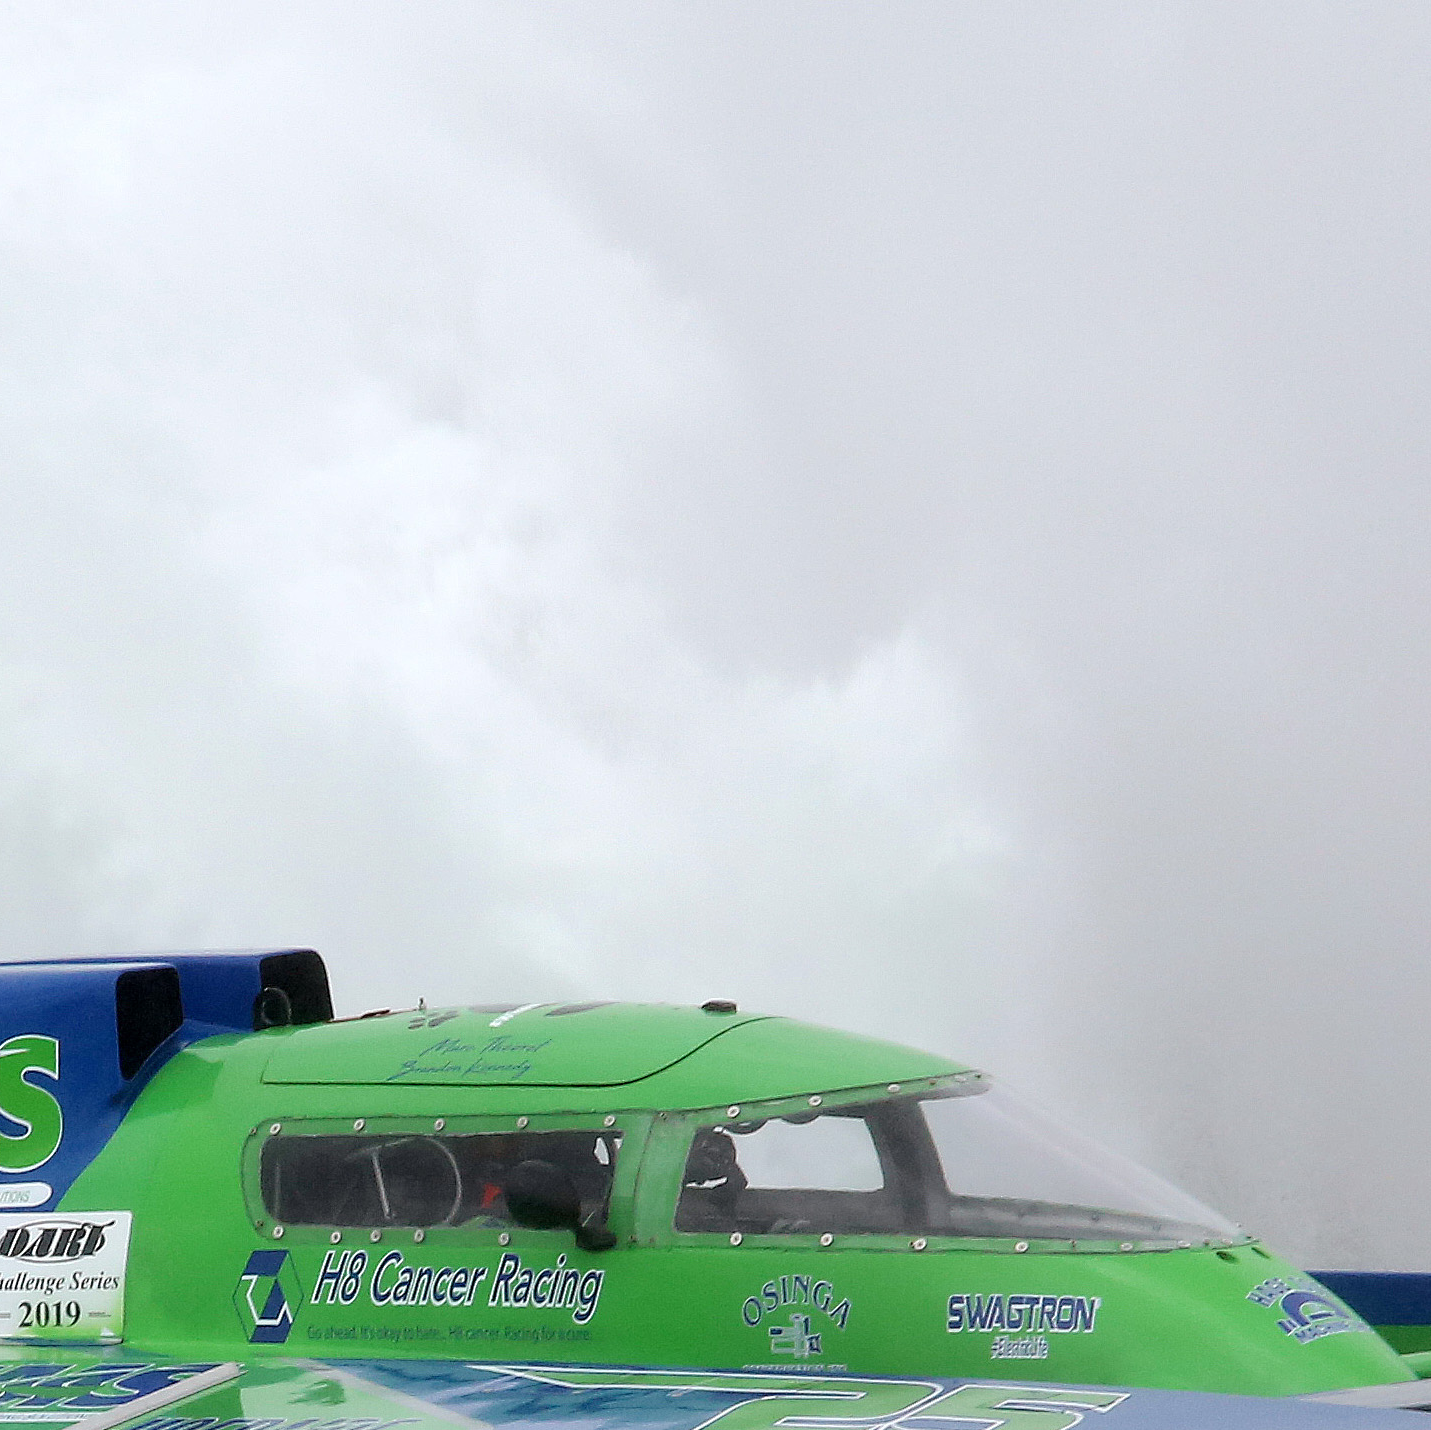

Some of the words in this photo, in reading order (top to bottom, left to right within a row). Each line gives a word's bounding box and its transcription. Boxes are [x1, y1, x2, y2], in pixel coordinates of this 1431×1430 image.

[69, 1270, 121, 1291] Series
[310, 1249, 369, 1306] H8
[369, 1250, 489, 1308] Cancer
[488, 1251, 606, 1326] Racing
[18, 1300, 82, 1329] 2019
[741, 1273, 852, 1331] OSINGA
[947, 1293, 1099, 1333] SWAGTRON
